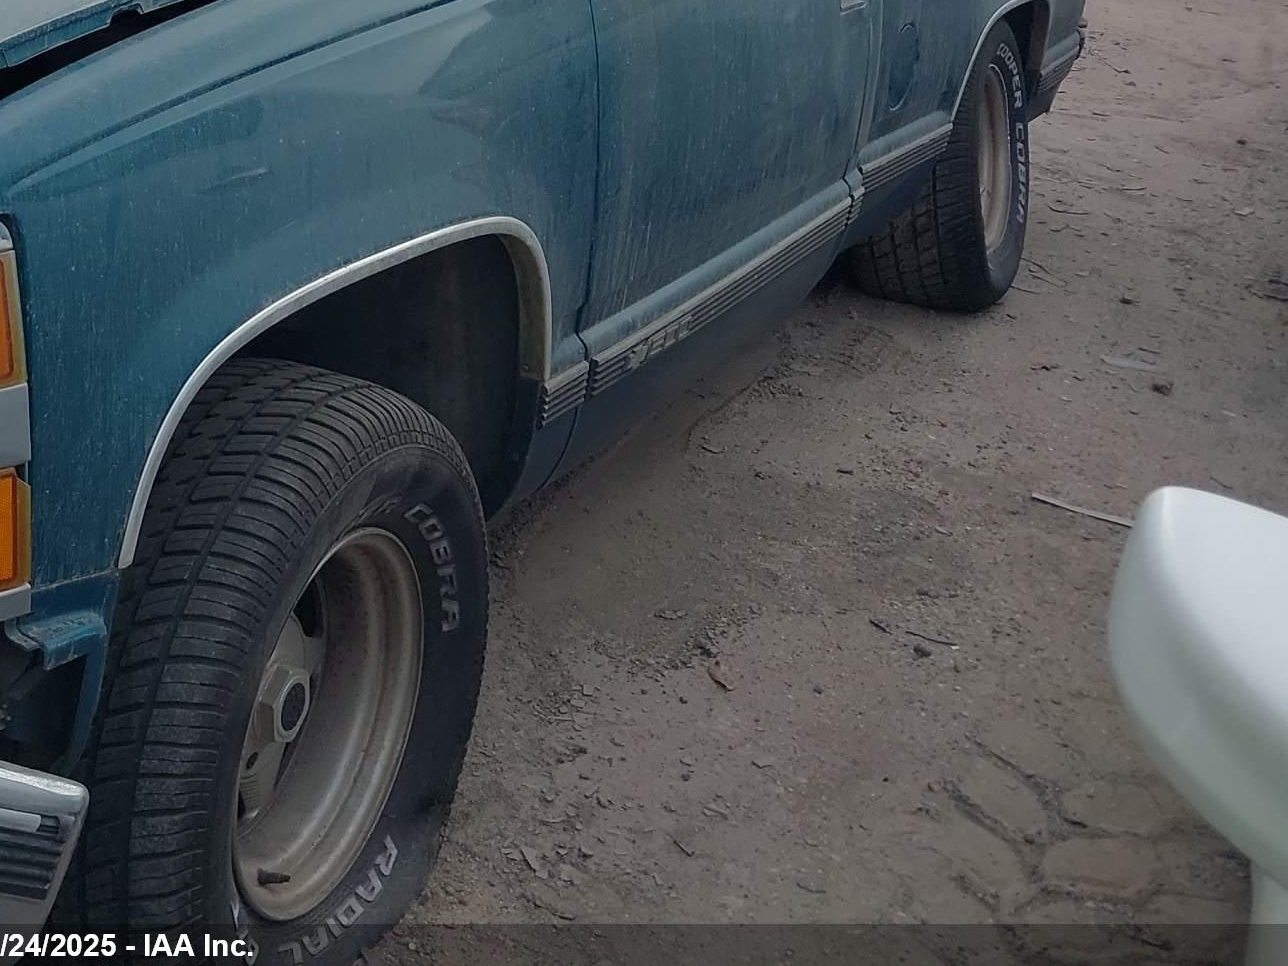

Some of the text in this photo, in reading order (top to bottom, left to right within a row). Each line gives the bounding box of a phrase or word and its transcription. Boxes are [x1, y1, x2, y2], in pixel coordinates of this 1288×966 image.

[996, 43, 1028, 223] COOPER COBRA
[403, 502, 460, 632] COBRA
[278, 834, 398, 965] RADIAL
